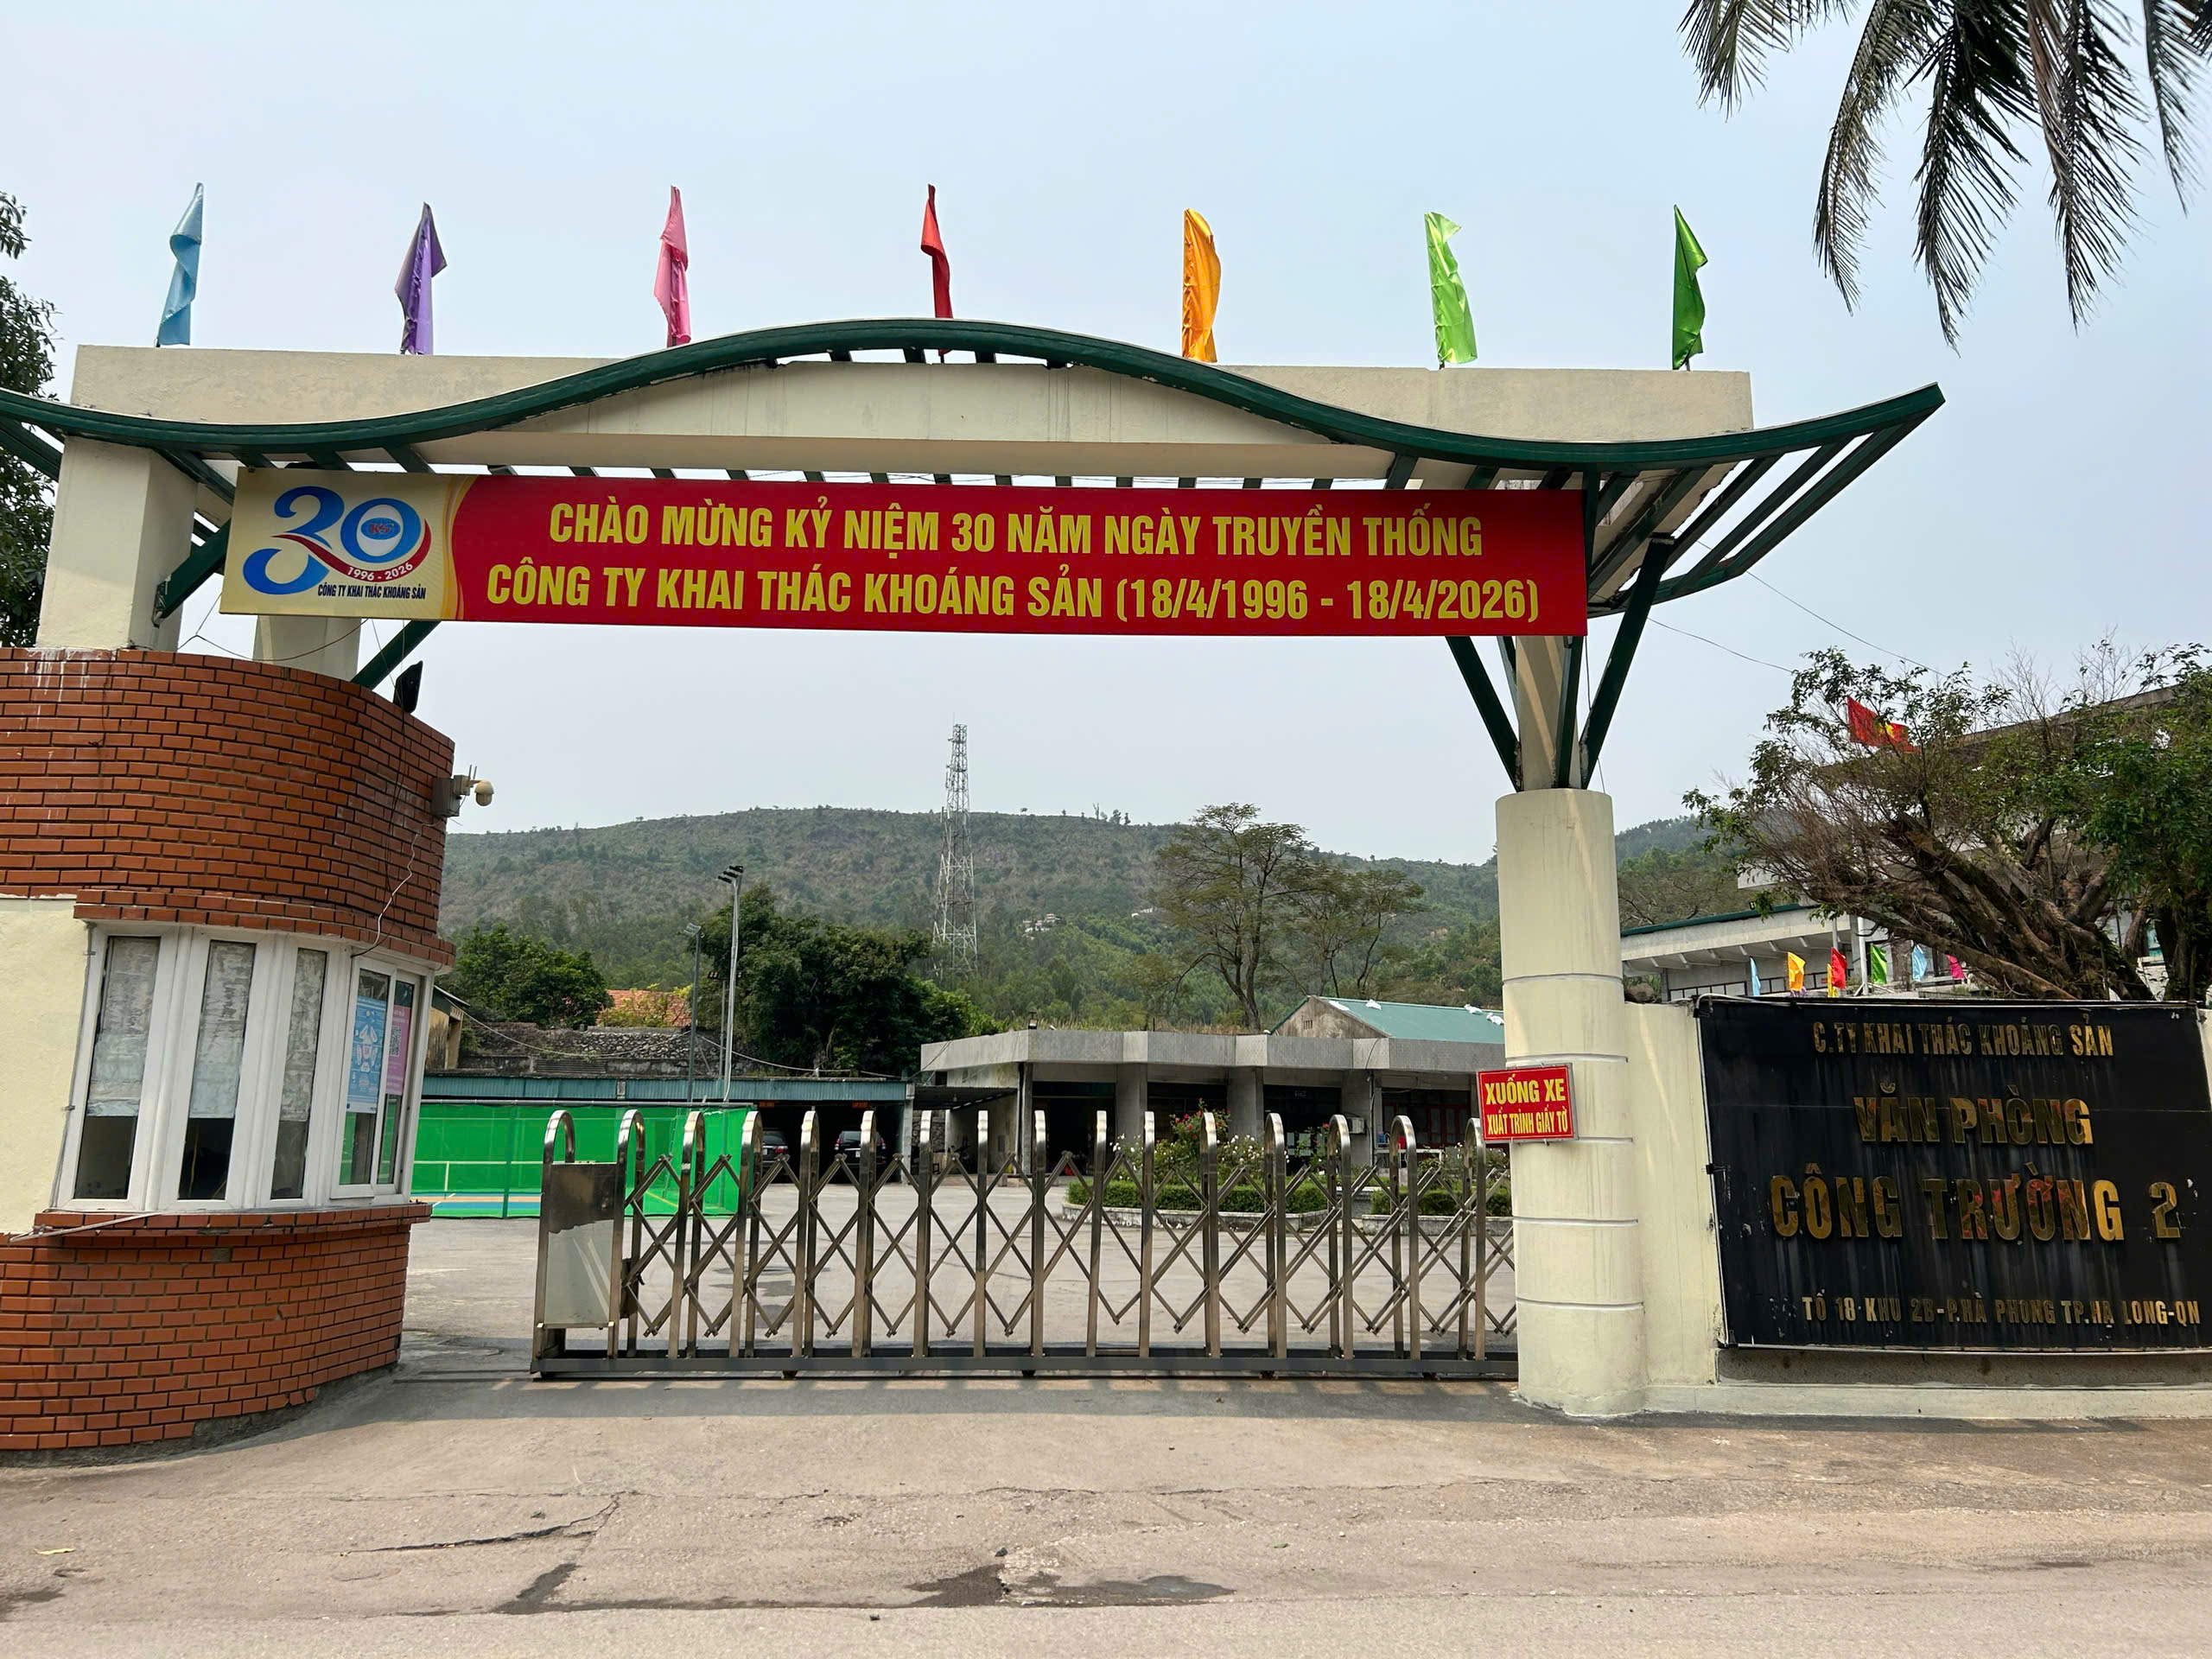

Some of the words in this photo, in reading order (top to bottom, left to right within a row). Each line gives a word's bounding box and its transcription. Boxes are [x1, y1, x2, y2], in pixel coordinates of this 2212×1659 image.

[243, 486, 422, 595] 30
[549, 495, 649, 544] CHÀO
[661, 498, 772, 548] MỪNG
[785, 495, 833, 550] KỶ
[843, 502, 939, 559] NIỆM
[951, 512, 995, 552] 30
[1007, 505, 1091, 555] NĂM
[1104, 506, 1201, 556] NGÀY
[1212, 504, 1351, 557] TRUYỀN
[1362, 502, 1483, 557] THỐNG
[318, 582, 337, 597] CÔNG
[338, 585, 346, 597] TY
[346, 585, 363, 598] KHAI
[365, 584, 382, 598] THÁC
[383, 584, 410, 599] KHOÁNG
[411, 583, 426, 600] SẢN
[347, 566, 374, 582] 1996
[385, 563, 413, 581] 2026
[486, 556, 591, 606] CÔNG
[602, 567, 646, 607] TY
[657, 569, 745, 610] KHAI
[757, 563, 852, 613] THÁC
[864, 567, 1015, 616] KHOÁNG
[1027, 563, 1103, 618] SẢN
[1116, 577, 1308, 623] (18/4/1996
[1320, 598, 1335, 607] -
[1346, 578, 1539, 624] 18/4/2026)
[1814, 1022, 1857, 1053] C.TY
[1863, 1022, 1915, 1054] KHAI
[1919, 1015, 1973, 1055] THÁC
[1978, 1015, 2064, 1056] KHOÁNG
[2069, 1013, 2115, 1057] SẢN
[1484, 1073, 1540, 1105] XUỐNG
[1543, 1078, 1566, 1103] XE
[1486, 1106, 1508, 1135] XUẤT
[1509, 1109, 1535, 1135] TRÌNH
[1535, 1104, 1555, 1134] GIẤY
[1556, 1106, 1568, 1133] TỜ
[1853, 1081, 1941, 1144] VĂN
[1949, 1085, 2094, 1146] PHÒNG
[1769, 1162, 1903, 1239] CÔNG
[1922, 1161, 2125, 1241] TRƯỜNG
[2148, 1181, 2181, 1239] 2
[1994, 1299, 2056, 1324] PHONG
